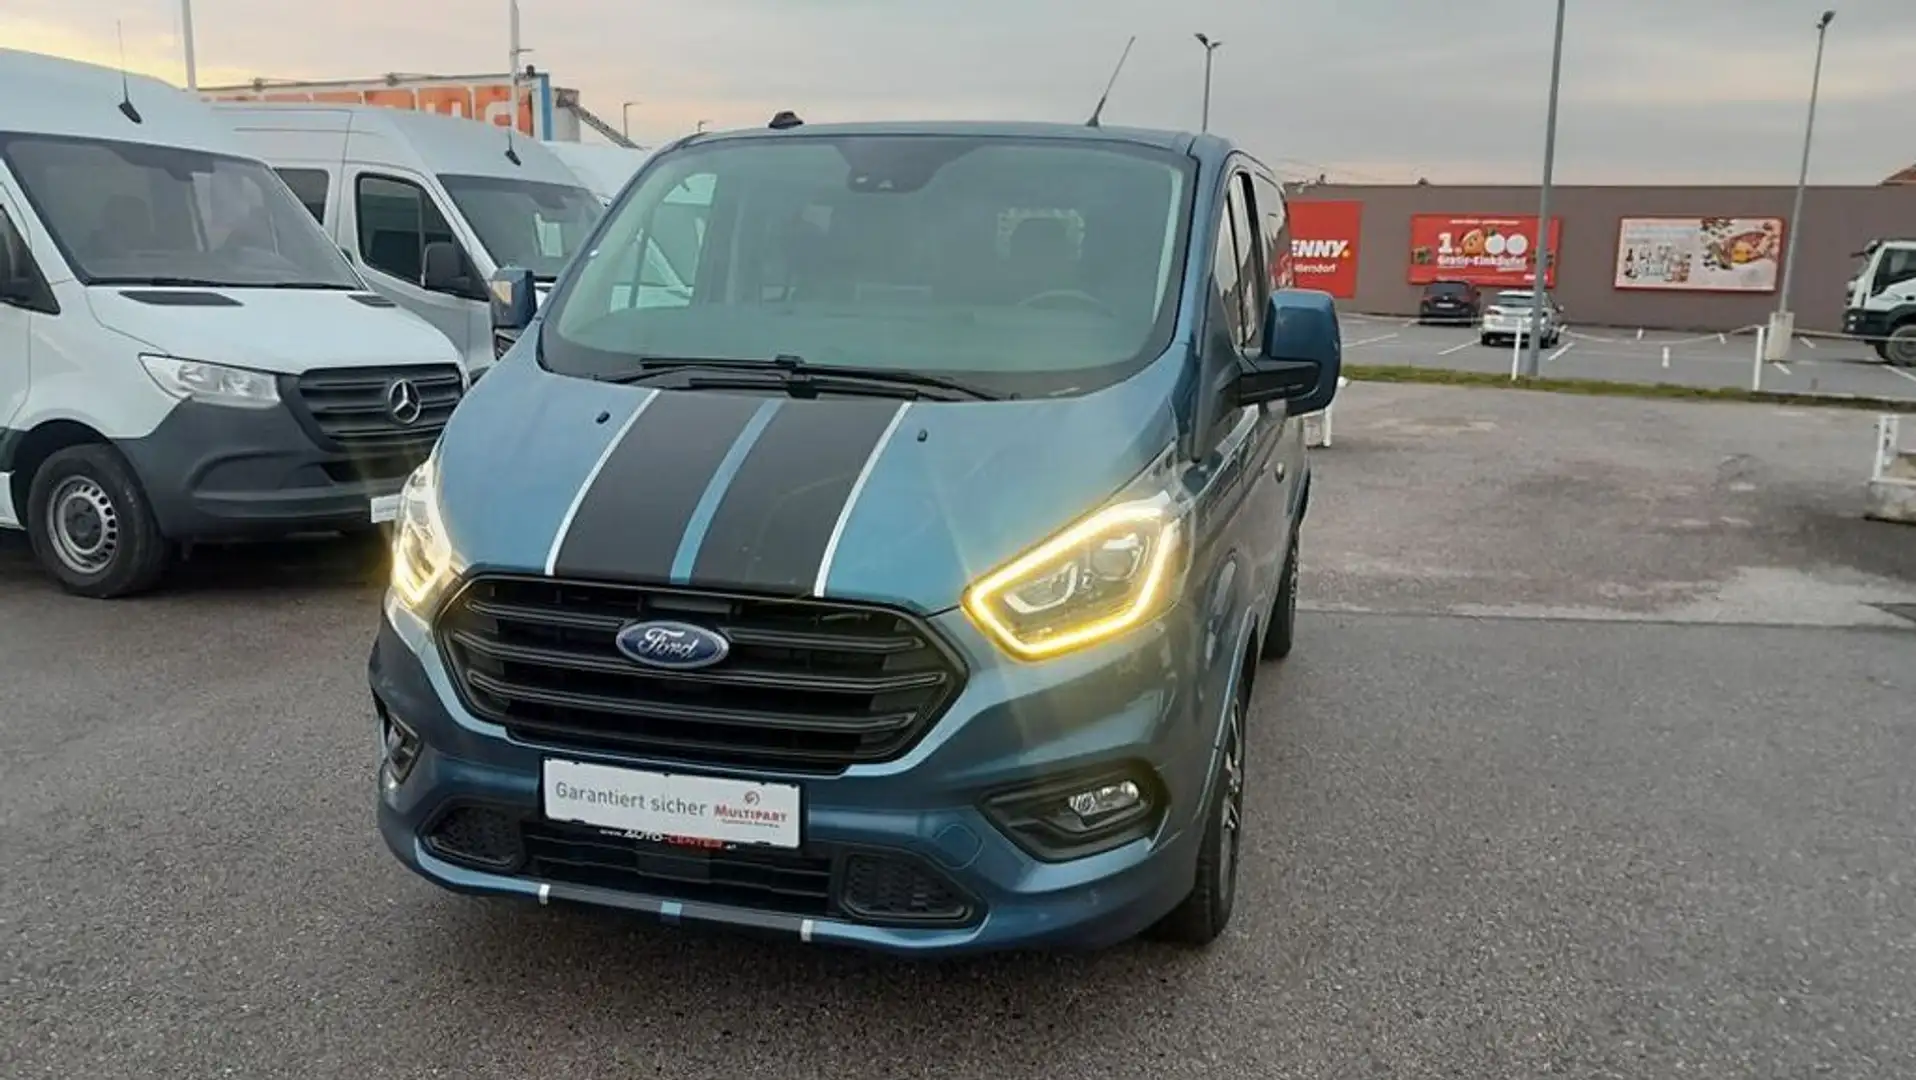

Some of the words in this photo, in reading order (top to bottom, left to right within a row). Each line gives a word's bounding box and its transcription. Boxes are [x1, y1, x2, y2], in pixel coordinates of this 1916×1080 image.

[1291, 239, 1351, 258] ENNY.
[636, 626, 701, 658] Ford
[555, 781, 645, 811] Garantiert
[650, 793, 708, 817] sicher
[713, 803, 788, 824] MULTIPART
